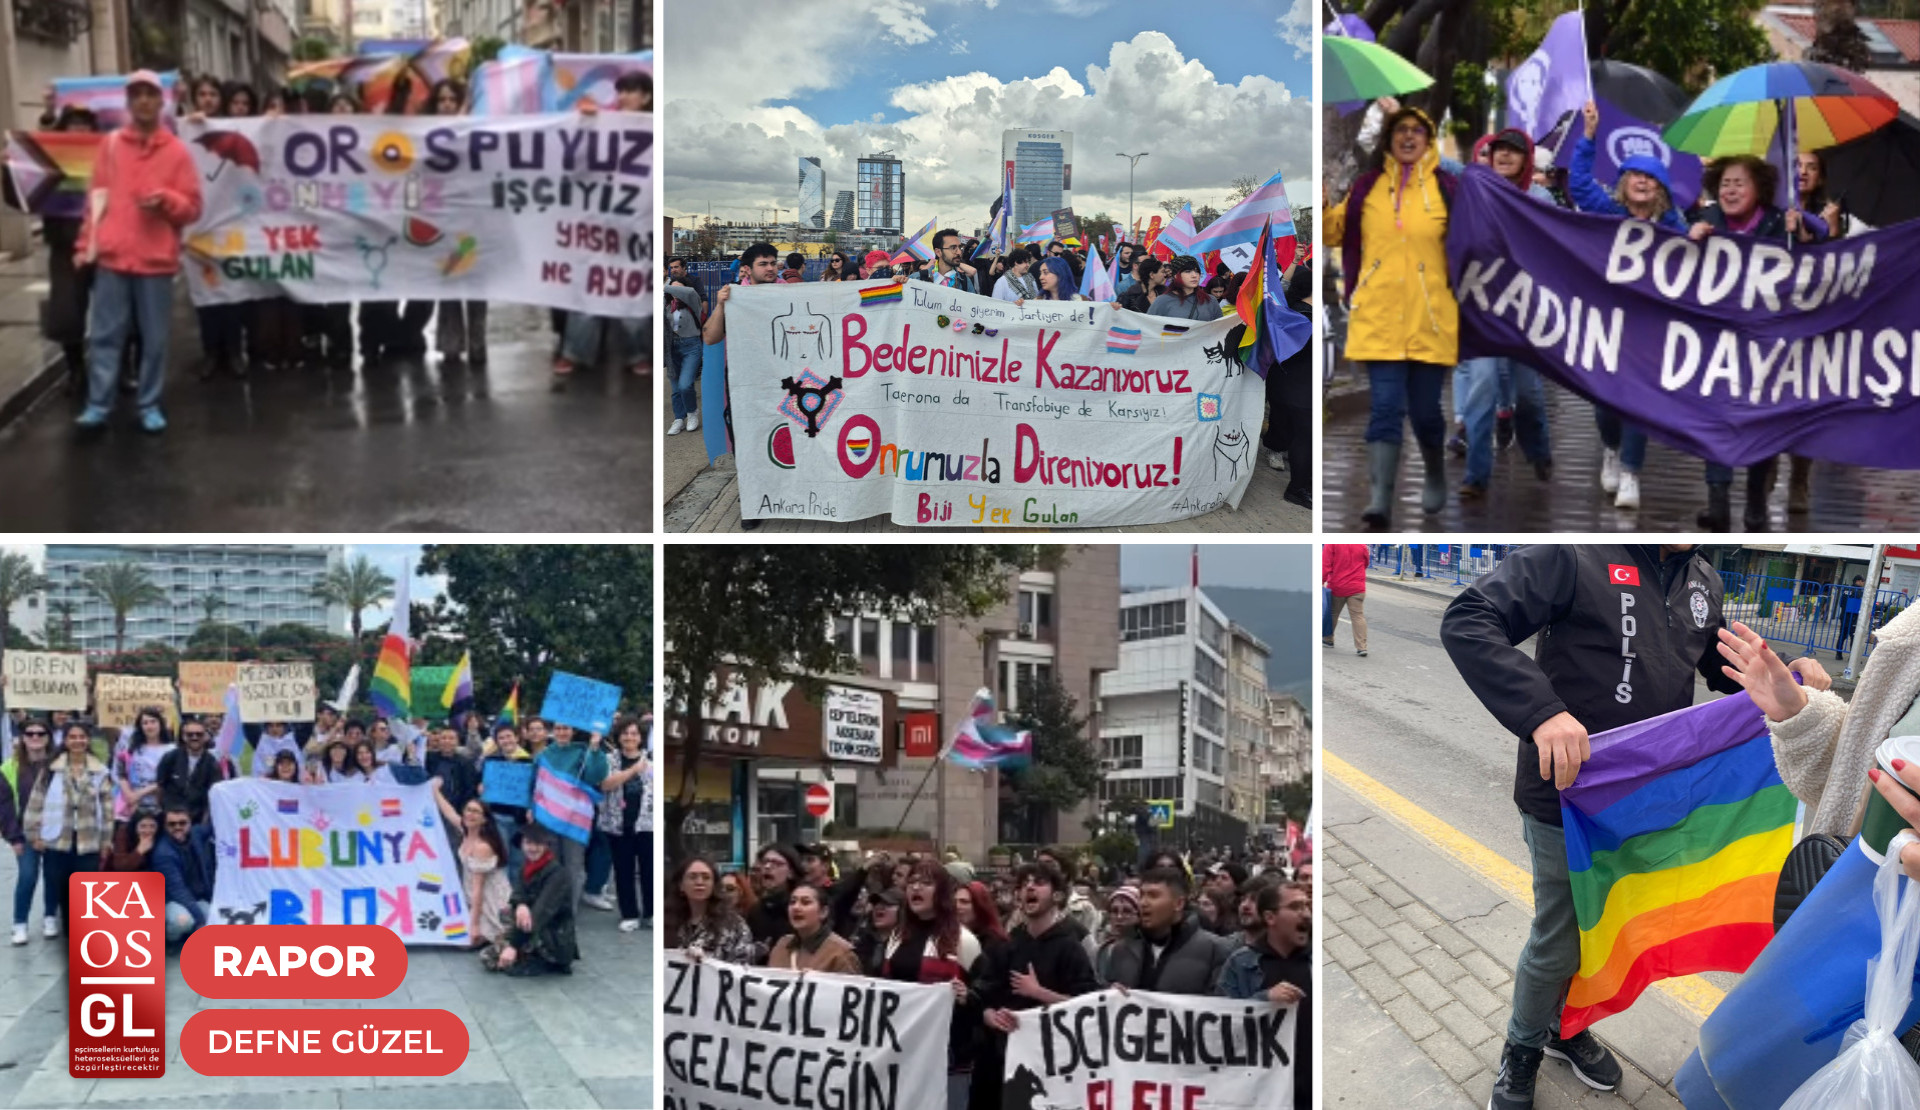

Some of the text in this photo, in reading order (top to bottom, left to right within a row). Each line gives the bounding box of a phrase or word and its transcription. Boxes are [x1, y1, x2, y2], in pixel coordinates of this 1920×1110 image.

[262, 226, 322, 253] YEK
[556, 220, 621, 254] YASA
[222, 253, 315, 281] GULAN
[1606, 219, 1877, 312] BODRUM
[910, 286, 942, 310] Tulum
[950, 299, 962, 312] da
[842, 313, 1192, 393] Bedenimizle Kazanıyoruz
[1457, 257, 1920, 408] KADIN DAYANIŞ
[880, 383, 941, 404] Taerona
[953, 389, 970, 405] da
[993, 392, 1071, 419] Transfobiye
[1078, 400, 1093, 417] de
[1013, 423, 1182, 489] Direniyoruz!
[757, 491, 838, 518] Ankara Pride
[917, 493, 1078, 524] Biji Yek Gulan
[1614, 592, 1637, 704] POLİS
[239, 827, 437, 869] LUBUNYA
[838, 982, 902, 1052] BİR
[664, 1032, 899, 1110] GELECEĞİN
